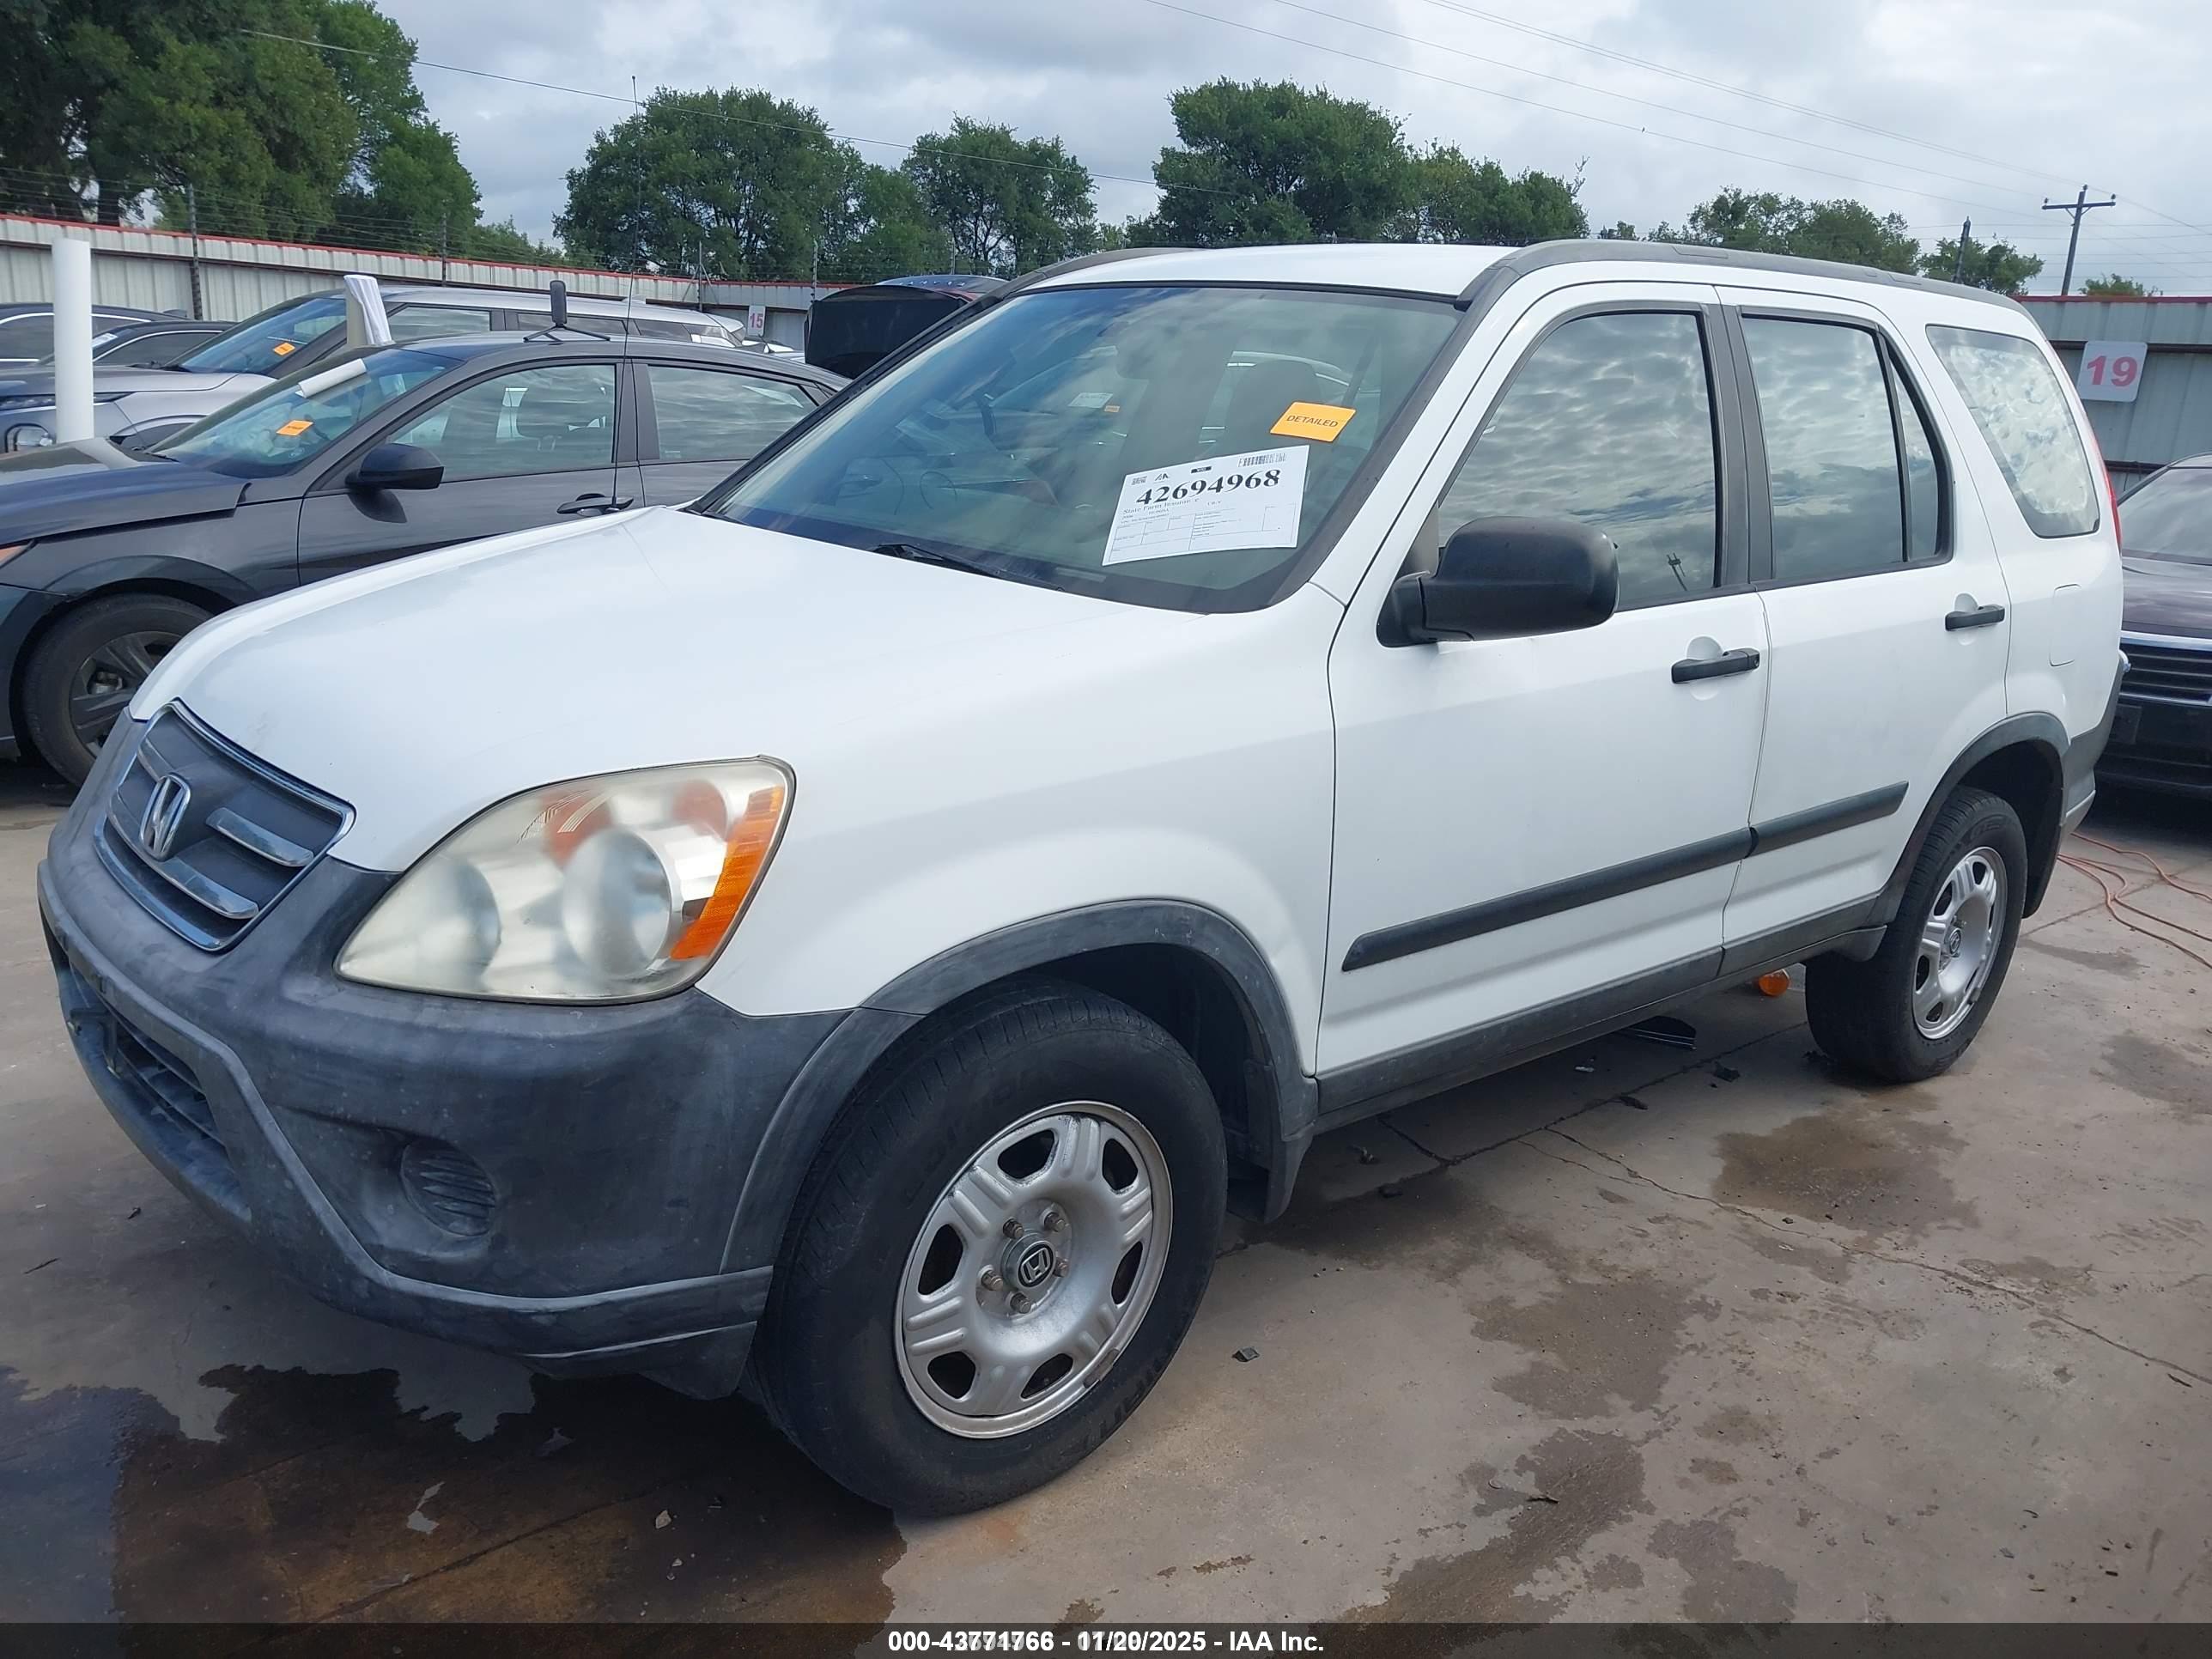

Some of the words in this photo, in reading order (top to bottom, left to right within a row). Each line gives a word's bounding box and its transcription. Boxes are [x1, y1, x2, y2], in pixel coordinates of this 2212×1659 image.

[750, 313, 763, 328] 15
[2087, 356, 2138, 386] 19
[1286, 415, 1339, 428] DETAILED
[1136, 469, 1281, 505] 42694968
